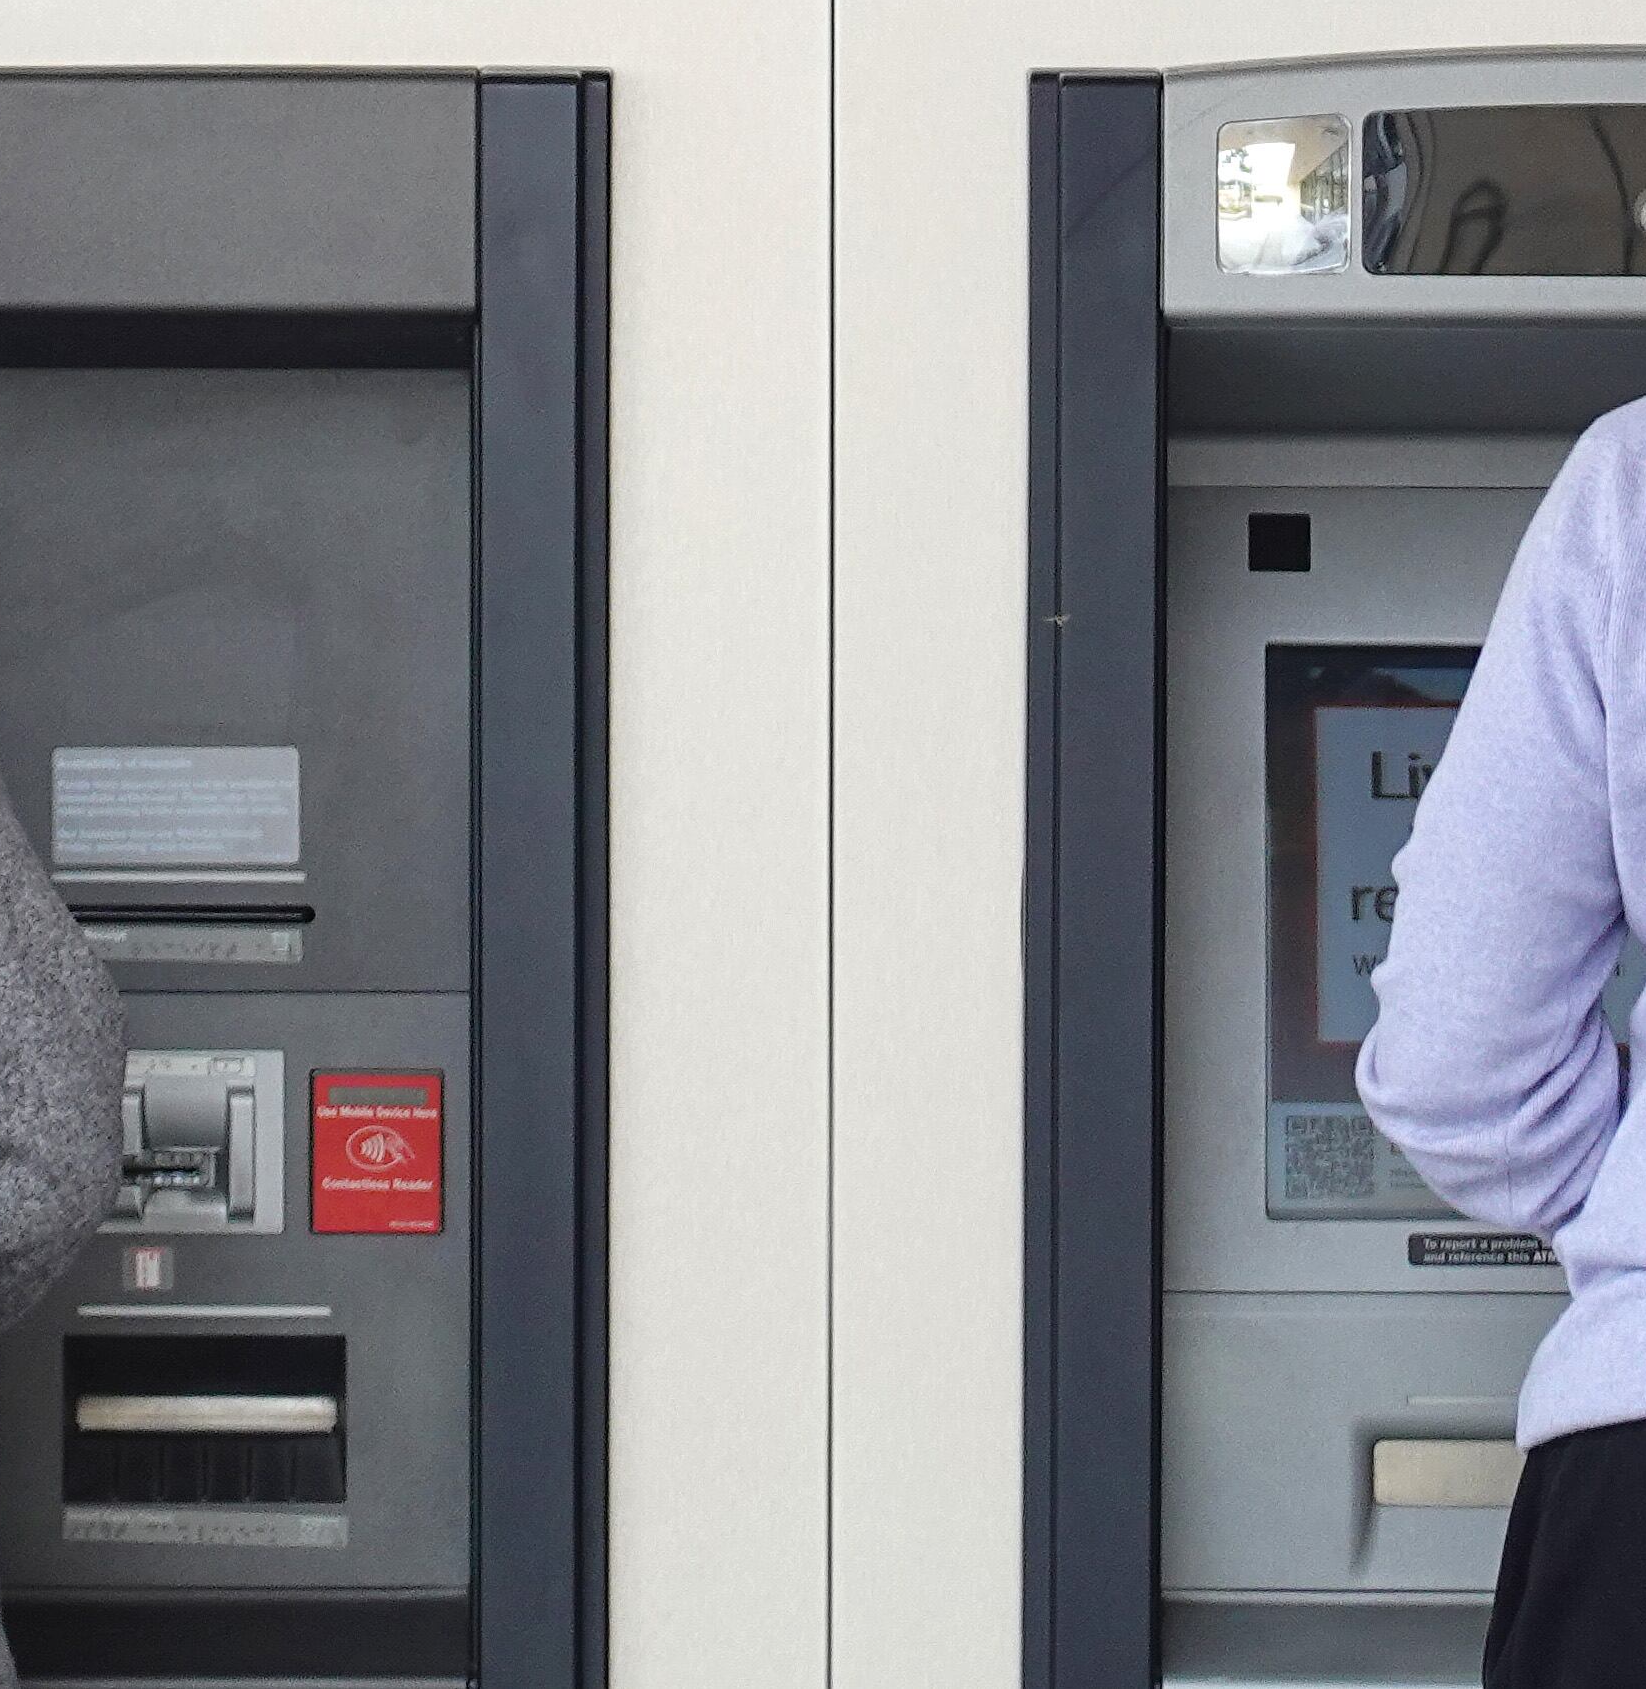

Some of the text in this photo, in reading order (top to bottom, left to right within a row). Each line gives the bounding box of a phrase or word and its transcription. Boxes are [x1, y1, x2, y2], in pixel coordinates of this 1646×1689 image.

[1440, 1238, 1477, 1251] report
[1490, 1238, 1538, 1251] problem
[1424, 1251, 1446, 1263] and
[1448, 1252, 1505, 1263] reference
[1506, 1251, 1530, 1263] this
